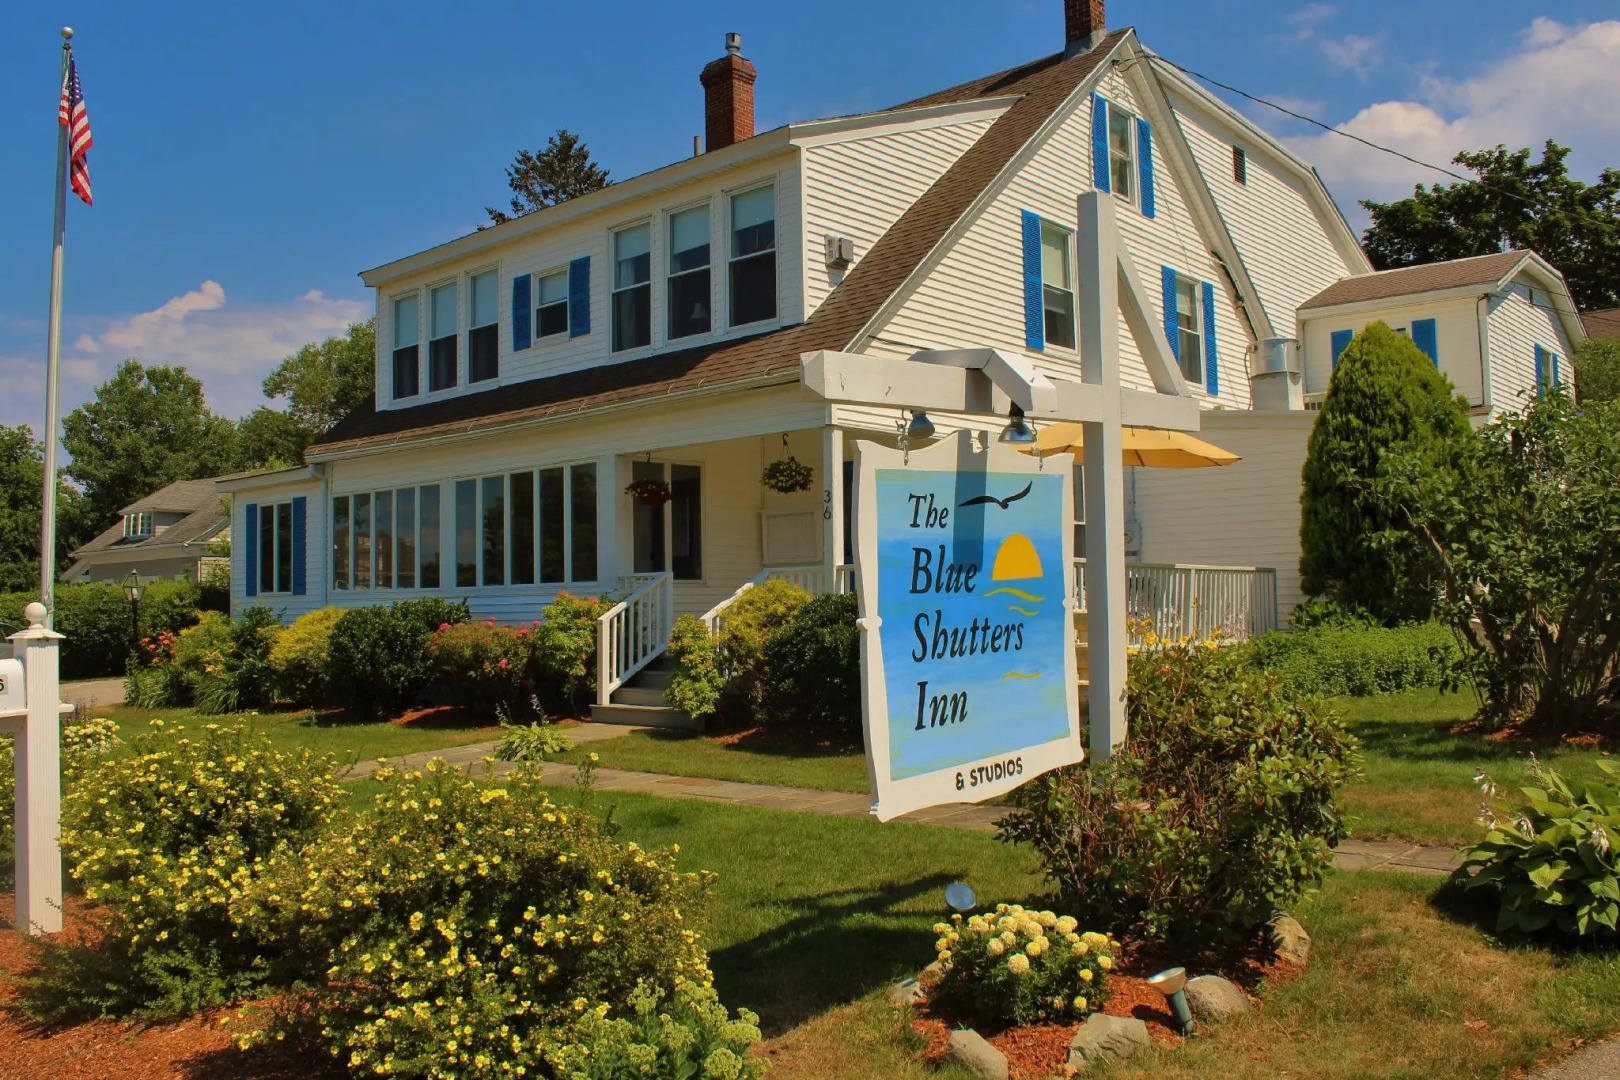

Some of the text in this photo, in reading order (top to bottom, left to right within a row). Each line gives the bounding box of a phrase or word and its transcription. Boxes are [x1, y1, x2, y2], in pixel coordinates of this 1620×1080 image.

[823, 489, 832, 520] 36
[908, 493, 949, 529] The
[909, 544, 978, 594] Blue
[912, 609, 1024, 663] Shutters
[914, 681, 968, 731] Inn
[955, 757, 1024, 791] & STUDIOS
